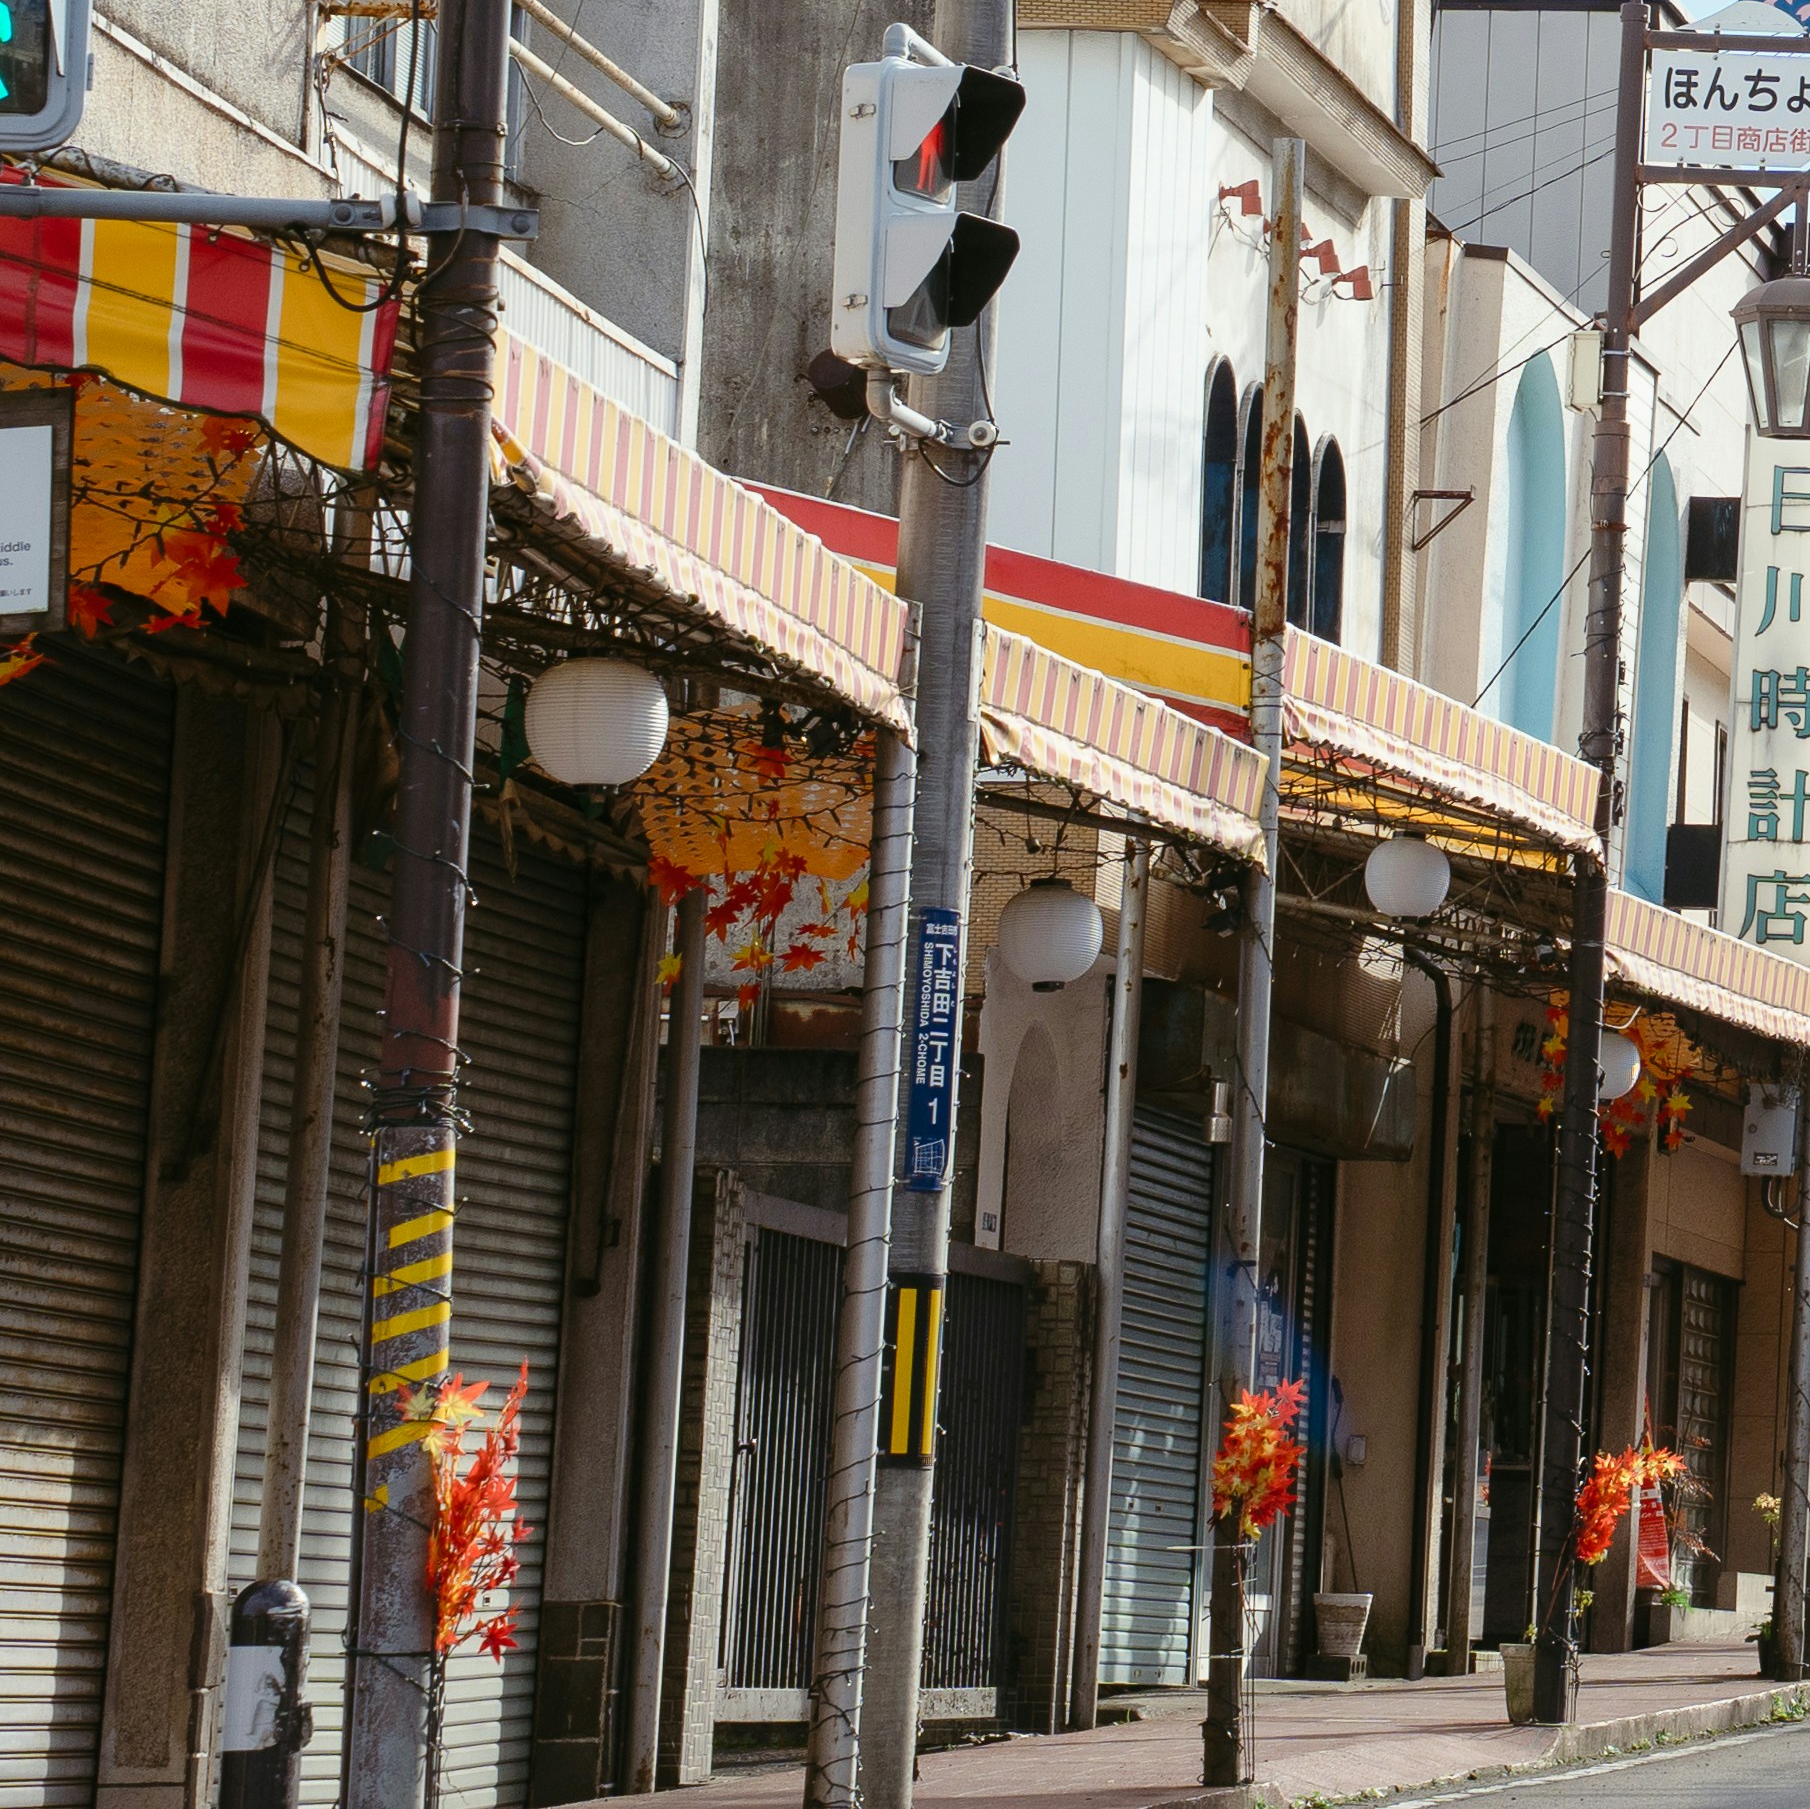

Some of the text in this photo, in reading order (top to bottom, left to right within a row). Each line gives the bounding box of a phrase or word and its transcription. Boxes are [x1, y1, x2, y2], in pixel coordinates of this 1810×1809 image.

[919, 942, 934, 1028] SHIMOYOSHIDA
[928, 943, 954, 1125] 下吉田二丁目 1
